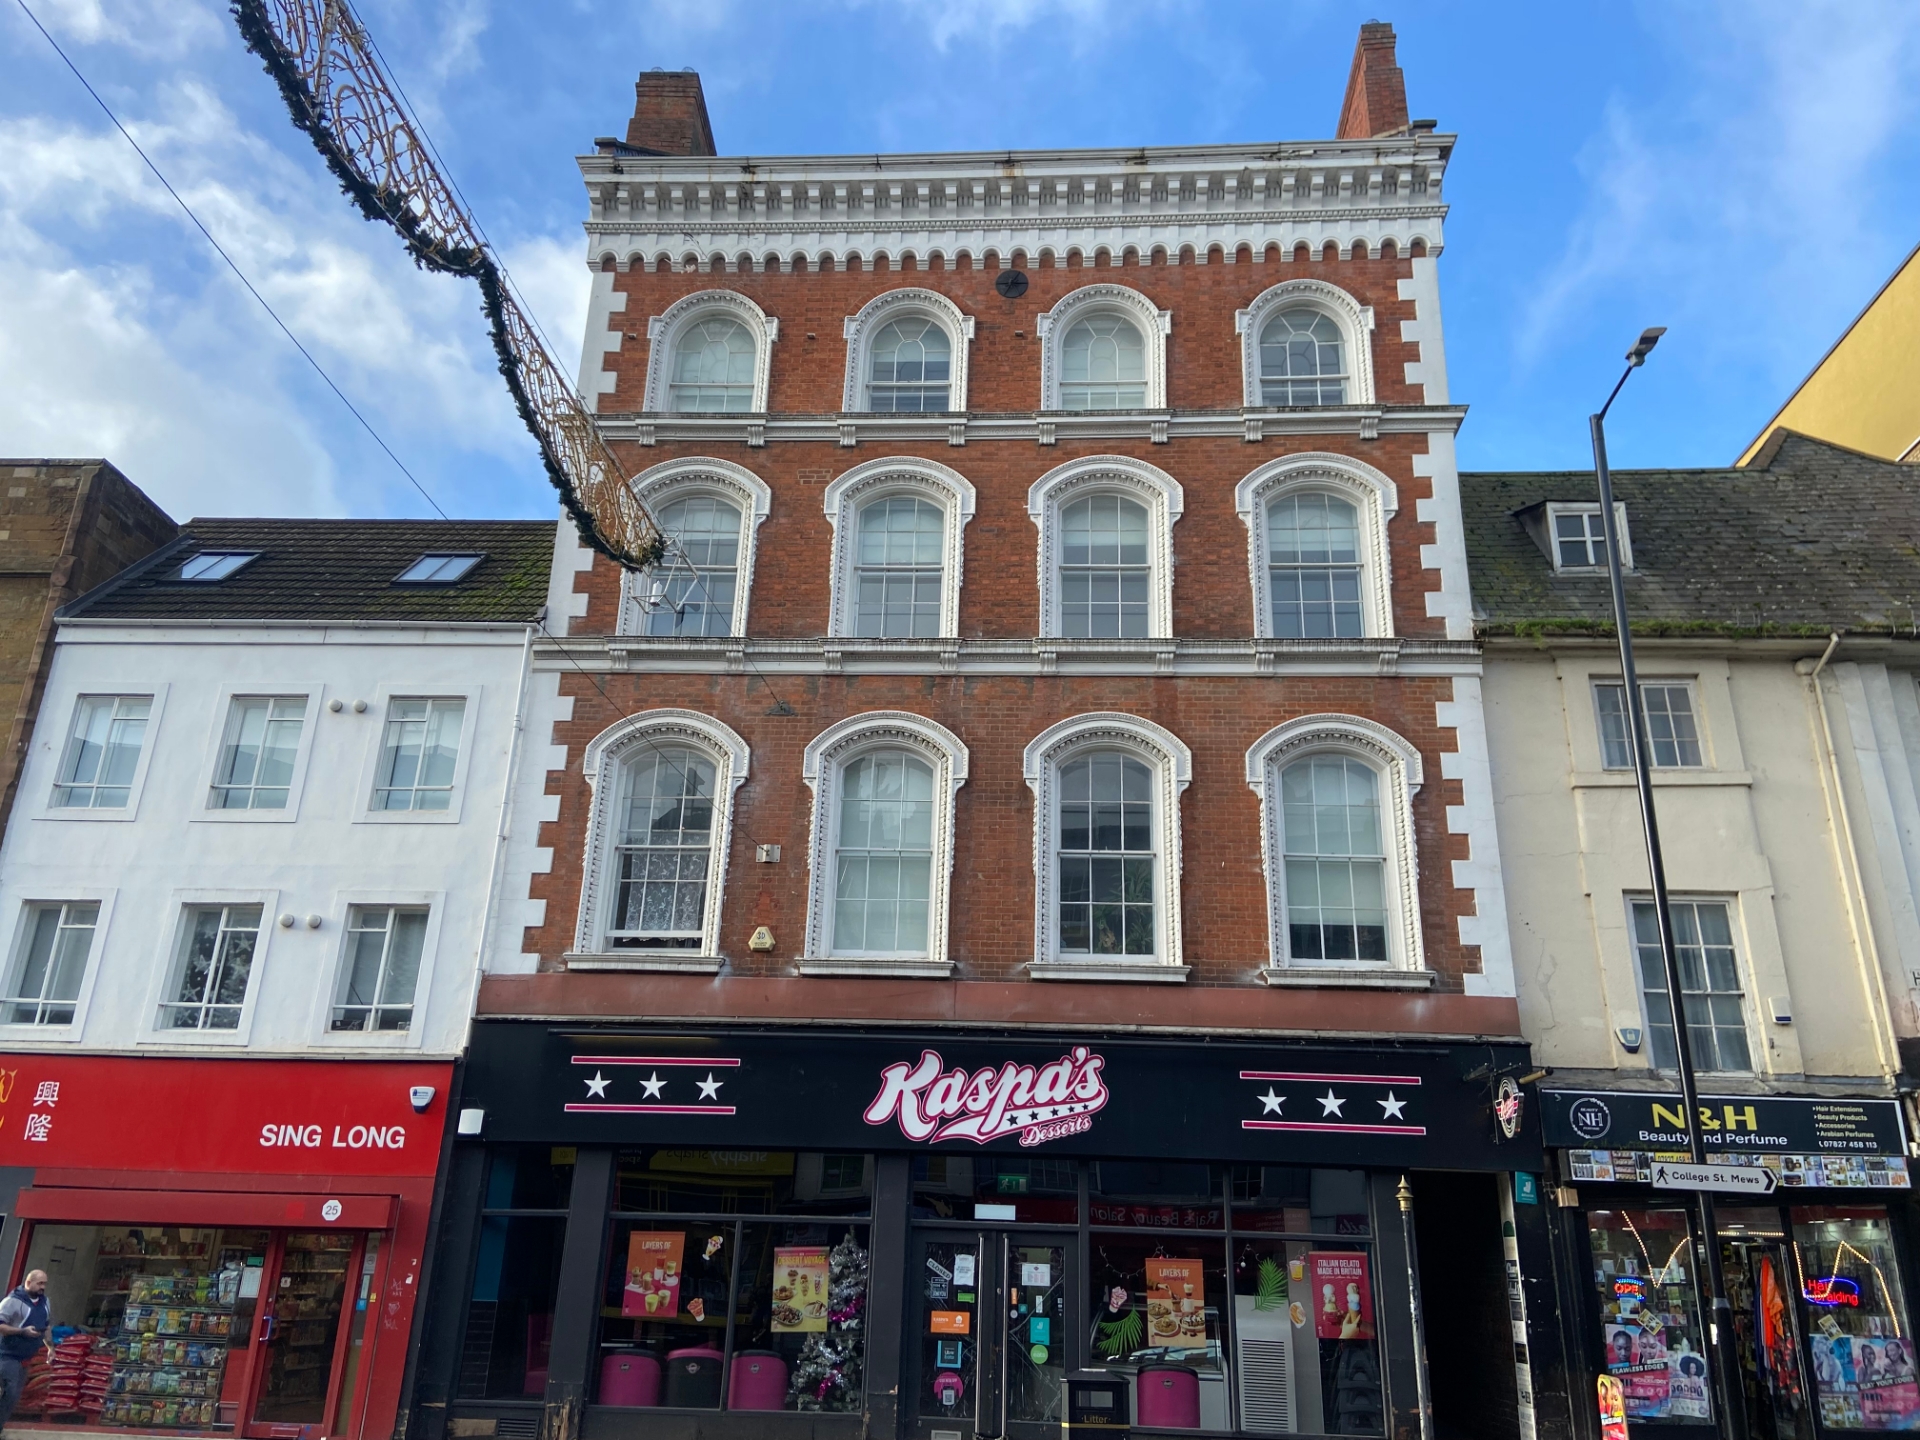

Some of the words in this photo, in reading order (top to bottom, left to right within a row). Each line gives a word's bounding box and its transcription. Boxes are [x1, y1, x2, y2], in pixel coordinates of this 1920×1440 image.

[863, 1046, 1108, 1143] Kaspa's
[24, 1081, 60, 1141] 興隆
[1578, 1112, 1604, 1127] NH
[260, 1124, 322, 1147] SING
[332, 1125, 405, 1148] LONG
[1019, 1114, 1091, 1147] Desserts
[1639, 1131, 1689, 1145] Beauty
[1726, 1133, 1788, 1146] Perfume
[1672, 1171, 1709, 1182] College
[1713, 1173, 1728, 1182] St.
[1731, 1174, 1760, 1184] Mews
[325, 1205, 338, 1215] 25
[642, 1241, 663, 1250] LAYERS
[664, 1241, 672, 1249] OF
[777, 1256, 802, 1265] DESSERT
[803, 1256, 826, 1265] VOYAGE
[929, 1260, 950, 1279] CLOSED
[1159, 1269, 1182, 1277] LAYERS
[1182, 1269, 1190, 1277] OF
[1614, 1283, 1647, 1294] OPEN
[1814, 1291, 1859, 1306] Braiding
[1612, 1365, 1643, 1374] FLAWLESS
[1644, 1363, 1665, 1371] EDGES
[1084, 1414, 1108, 1424] Litter
